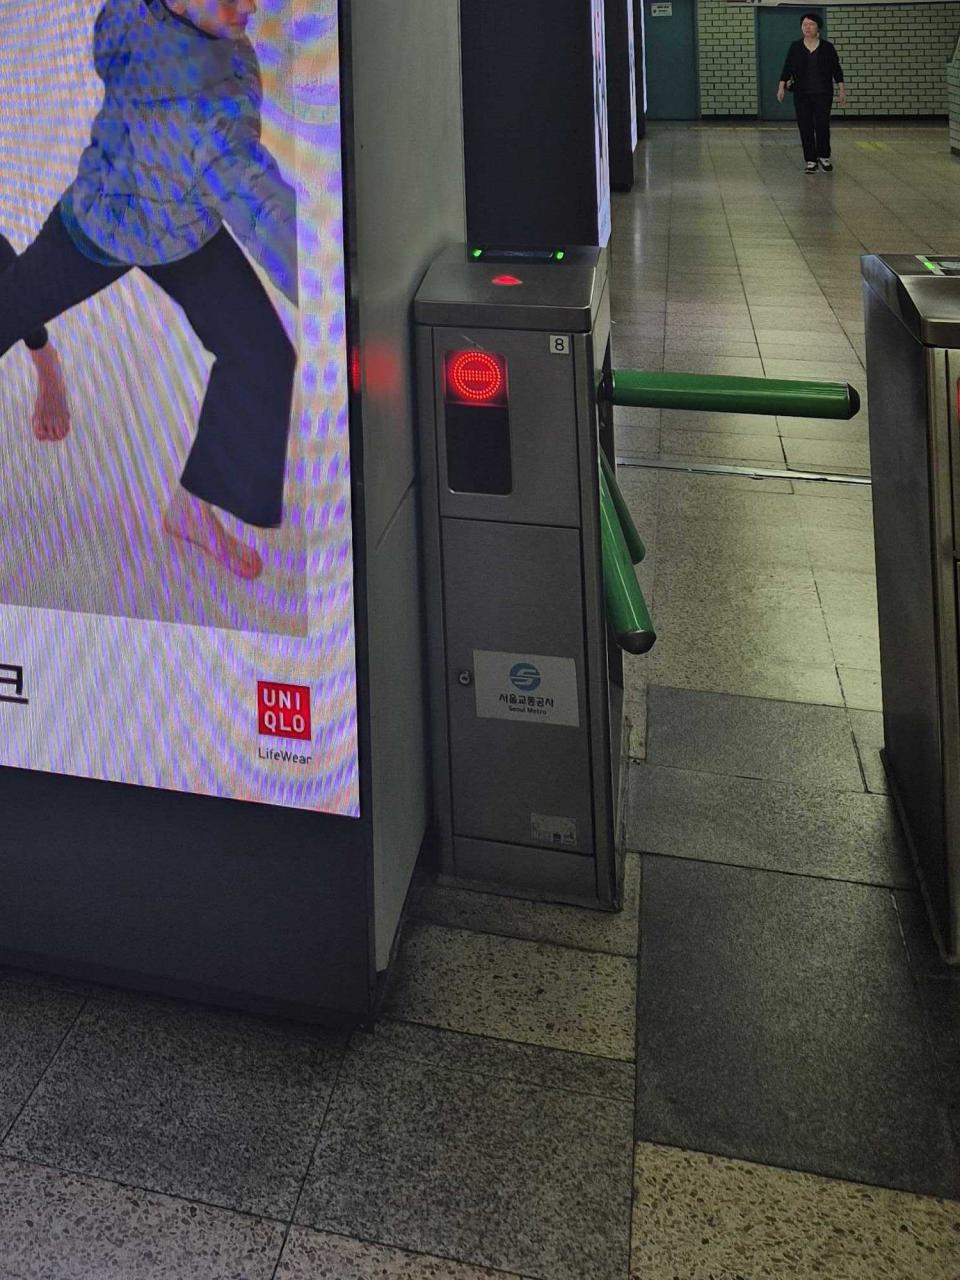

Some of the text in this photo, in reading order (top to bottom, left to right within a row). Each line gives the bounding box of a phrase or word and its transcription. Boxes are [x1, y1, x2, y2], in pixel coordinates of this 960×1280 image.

[554, 337, 565, 351] 8
[263, 688, 300, 711] UNI
[499, 693, 554, 708] 서울교통공사
[527, 707, 547, 715] Metro
[264, 710, 305, 733] QLO
[258, 747, 312, 765] LifeWear
